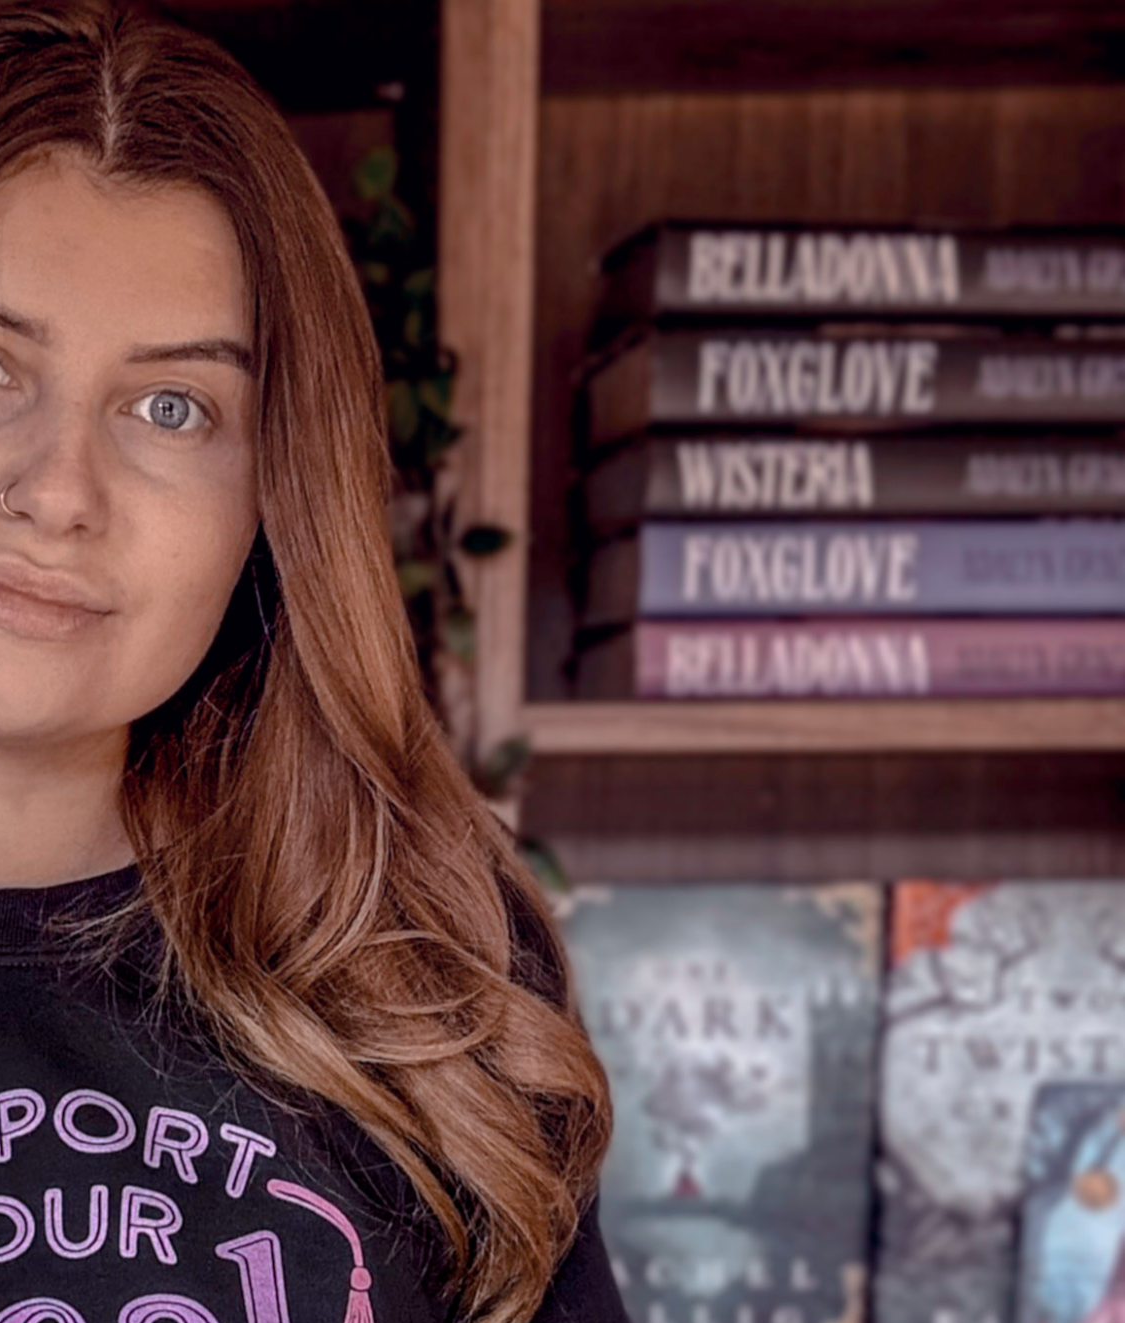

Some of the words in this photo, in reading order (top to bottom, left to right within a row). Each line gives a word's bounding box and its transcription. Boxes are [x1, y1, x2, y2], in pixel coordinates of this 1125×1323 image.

[688, 231, 960, 303] BELLADONNA
[697, 340, 938, 416] FOXGLOVE
[678, 442, 873, 508] WISTERIA
[683, 534, 918, 602] FOXGLOVE
[667, 633, 930, 697] BELLADONNA
[597, 996, 793, 1042] DARK
